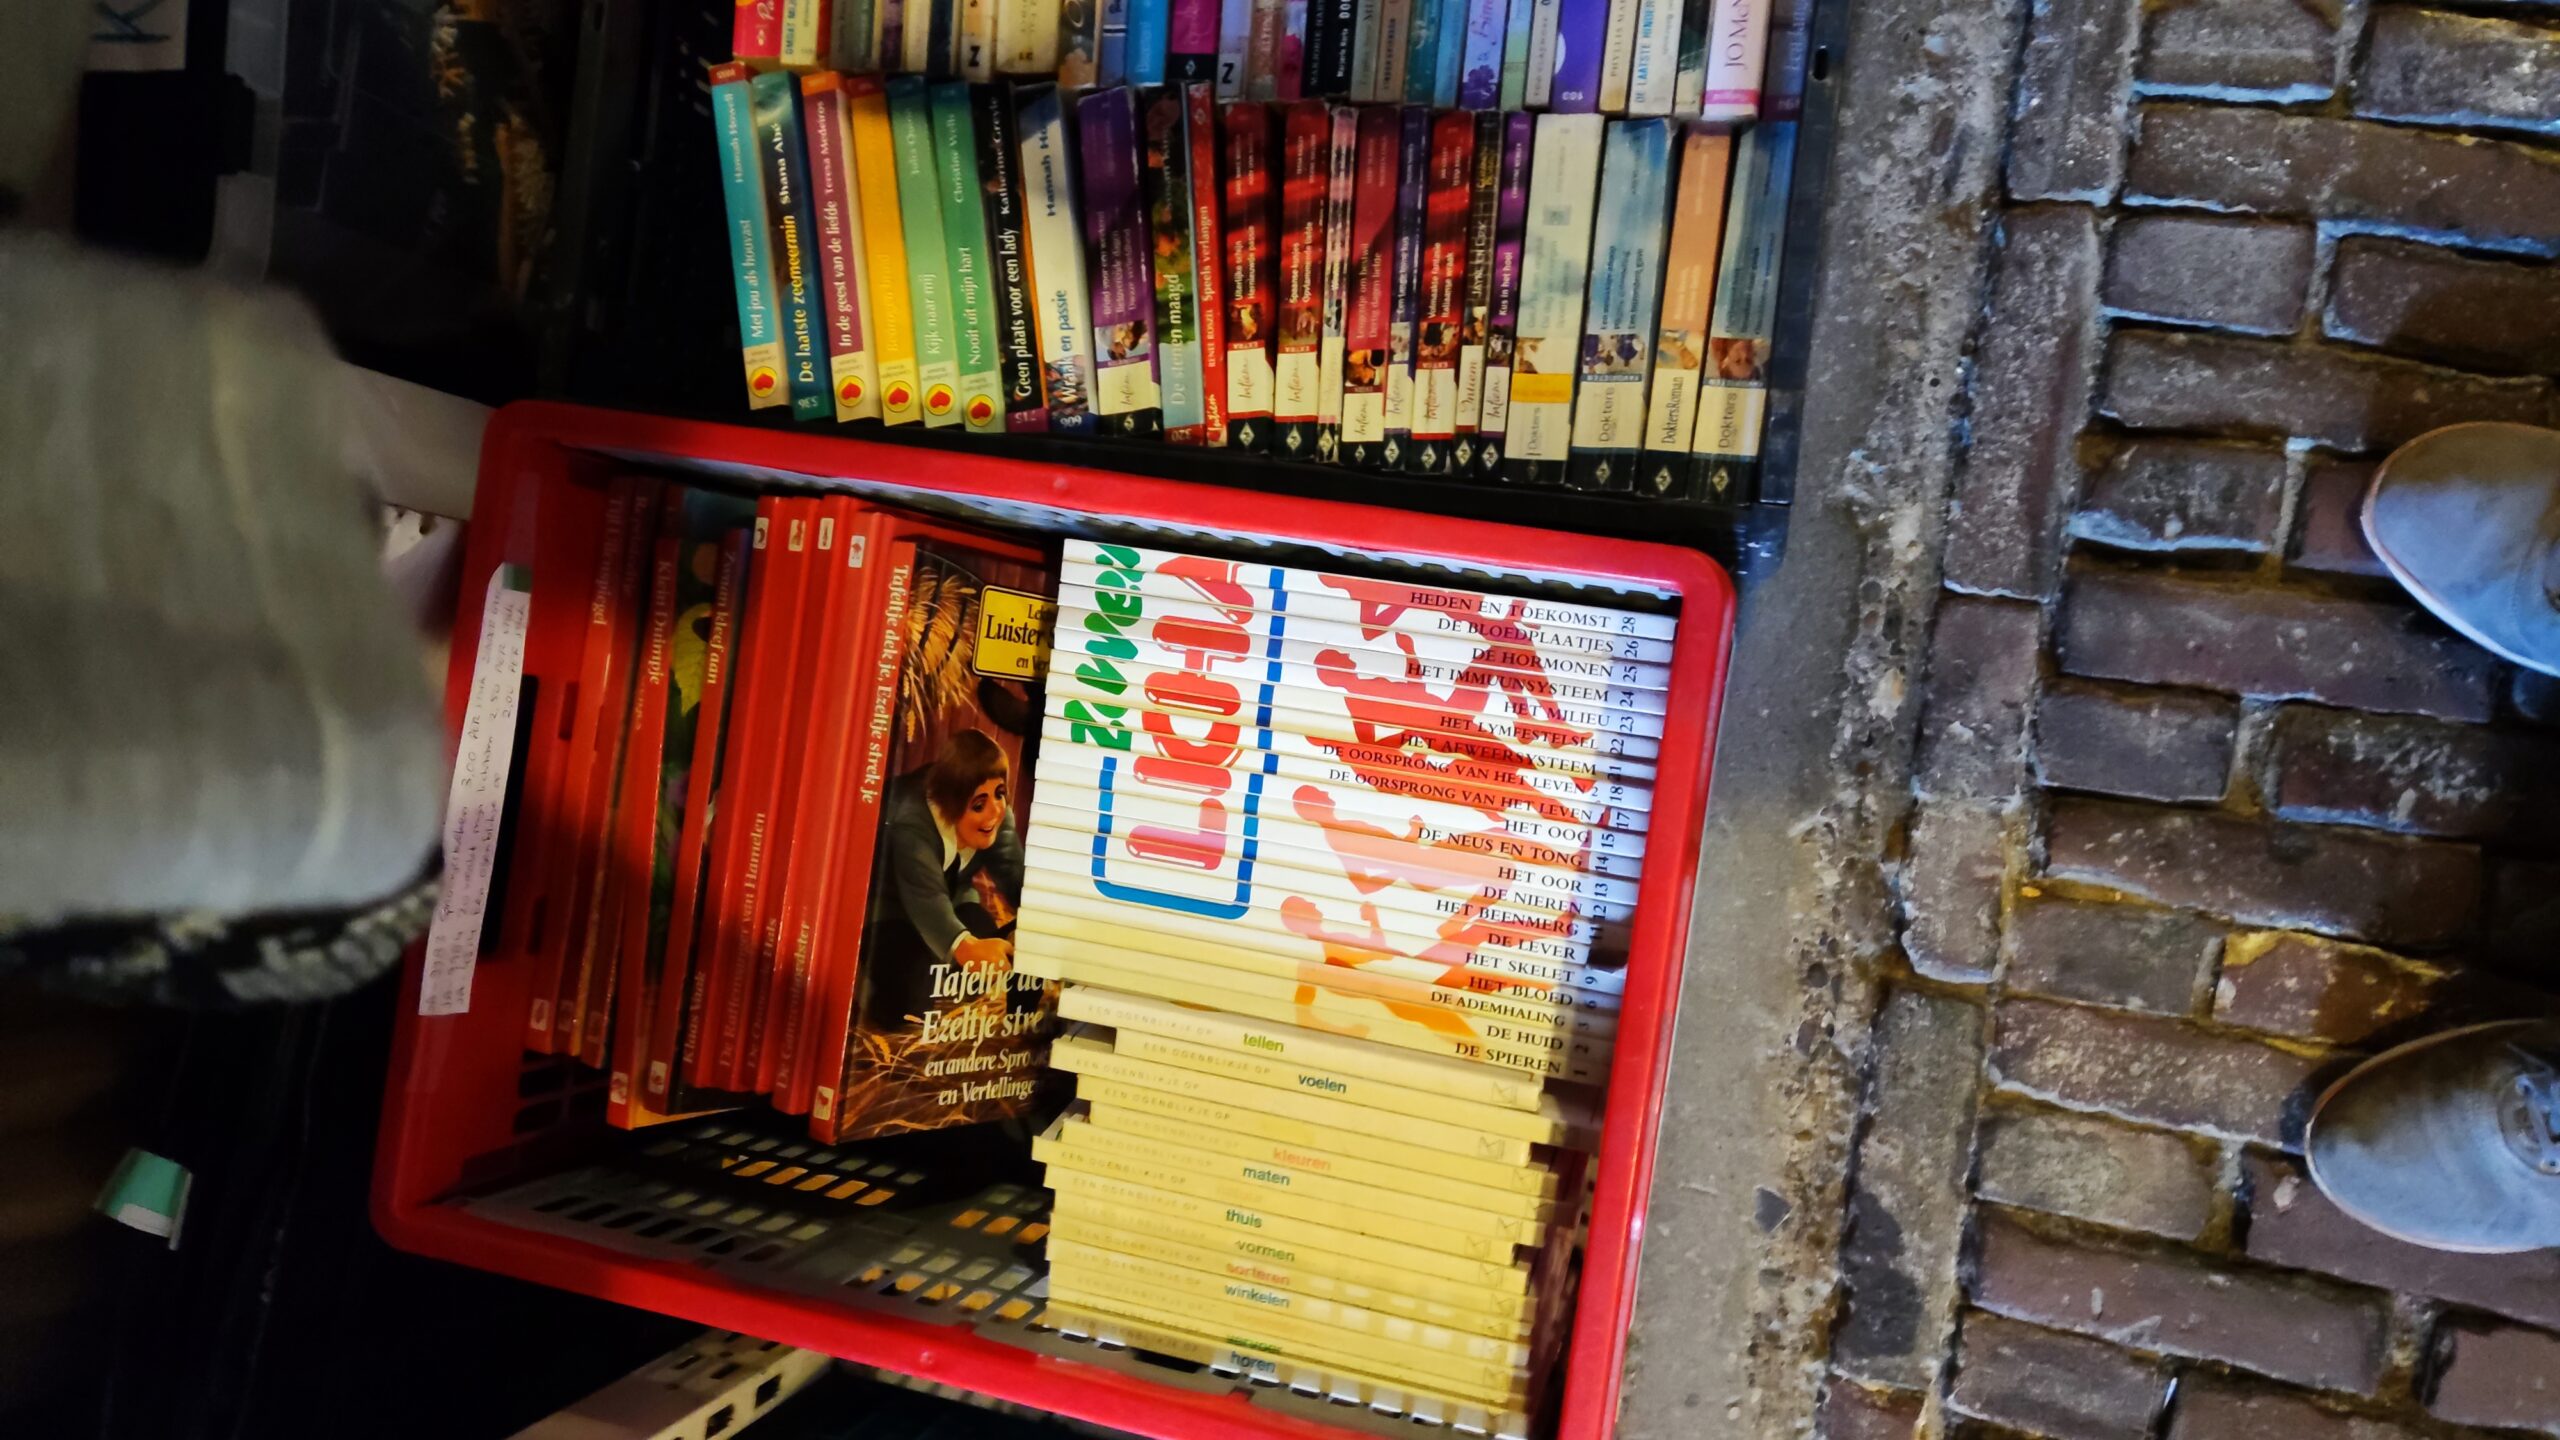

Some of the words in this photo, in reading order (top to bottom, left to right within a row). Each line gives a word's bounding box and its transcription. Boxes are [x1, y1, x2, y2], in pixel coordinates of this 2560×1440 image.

[777, 158, 792, 205] Shana
[822, 158, 834, 195] Teresa
[1042, 154, 1056, 217] Hannah
[825, 200, 841, 234] liefde
[739, 219, 757, 267] houvast
[827, 237, 843, 254] de
[999, 227, 1019, 256] lady
[1197, 206, 1214, 263] verlangen
[782, 216, 806, 304] zeemeermin
[833, 256, 846, 278] van
[958, 247, 973, 272] hart
[1006, 260, 1019, 283] een
[745, 270, 759, 287] als
[922, 273, 939, 295] mij
[961, 276, 979, 303] mijn
[1200, 265, 1216, 302] Speels
[1501, 271, 1511, 287] het
[747, 291, 765, 311] jou
[831, 281, 852, 312] geest
[1008, 286, 1022, 316] voor
[1164, 273, 1185, 324] maagd
[1499, 289, 1509, 298] in
[925, 301, 938, 327] naar
[964, 308, 978, 324] uit
[1052, 290, 1075, 331] passie
[1498, 300, 1508, 316] Kus
[750, 312, 765, 338] Met
[793, 310, 812, 357] laatste
[835, 315, 850, 331] de
[838, 333, 852, 347] In
[926, 330, 943, 355] Kijk
[967, 329, 982, 365] Nooit
[1010, 320, 1033, 358] plaats
[1060, 335, 1072, 352] en
[1168, 329, 1185, 379] stenen
[799, 361, 815, 384] De
[1016, 362, 1033, 397] Geen
[1058, 357, 1078, 403] Wraak
[1170, 382, 1186, 405] De
[1599, 386, 1615, 443] Dokters
[1718, 391, 1739, 449] Dokters
[655, 560, 673, 606] Klein
[886, 564, 910, 627] Tafeltje
[1410, 591, 1472, 611] HEDEN
[1478, 601, 1501, 615] EN
[1508, 604, 1612, 629] TOEKOMST
[710, 611, 729, 652] kleef
[985, 614, 1042, 647] Luister
[1438, 617, 1462, 631] DE
[1468, 621, 1615, 653] BLOEDPLAATJES
[1622, 615, 1636, 634] 28
[647, 611, 669, 685] Duimpje
[881, 629, 900, 659] dek
[1623, 640, 1639, 658] 26
[706, 652, 720, 684] aan
[876, 661, 896, 682] je,
[1016, 656, 1029, 669] en
[1472, 647, 1496, 662] DE
[1501, 651, 1613, 678] HORMONEN
[1622, 664, 1638, 683] 25
[1407, 662, 1444, 680] HET
[1449, 668, 1610, 702] IMMUUNSYSTEEM
[868, 684, 893, 740] Ezeltje
[1620, 690, 1635, 707] 24
[1503, 701, 1538, 716] HET
[1546, 707, 1611, 728] MILIEU
[1619, 716, 1635, 733] 23
[1439, 715, 1471, 731] HET
[1477, 721, 1600, 750] LYMFESTELSEL
[1404, 734, 1438, 748] HET
[1443, 740, 1597, 776] AFWEERSYSTEEM
[1609, 738, 1625, 755] 22
[864, 742, 883, 785] strek
[1323, 743, 1344, 758] DE
[1348, 748, 1449, 774] OORSPRONG
[1455, 765, 1488, 781] VAN
[1493, 770, 1526, 786] HET
[1532, 776, 1585, 796] LEVEN
[859, 786, 879, 804] je
[1328, 768, 1351, 782] DE
[1355, 773, 1456, 799] OORSPRONG
[1461, 789, 1496, 806] VAN
[1500, 795, 1535, 811] HET
[1539, 801, 1593, 822] LEVEN
[1609, 784, 1624, 802] 18
[1504, 819, 1540, 836] HET
[1548, 825, 1590, 843] OOG
[1616, 811, 1631, 828] 17
[744, 812, 766, 888] Hamelen
[1418, 826, 1442, 841] DE
[1447, 833, 1493, 852] NEUS
[1499, 841, 1524, 857] EN
[1529, 846, 1583, 867] TONG
[1601, 832, 1615, 849] 15
[1595, 856, 1609, 872] 14
[1497, 865, 1535, 882] HET
[1540, 874, 1583, 892] OOR
[1594, 882, 1608, 898] 13
[742, 893, 755, 923] van
[1483, 885, 1507, 900] DE
[1513, 891, 1583, 913] NIEREN
[1593, 904, 1608, 921] 12
[1436, 899, 1473, 917] HET
[1479, 906, 1579, 938] BEENMERG
[1487, 932, 1512, 948] DE
[1518, 939, 1576, 960] LEVER
[1465, 952, 1501, 969] HET
[1507, 960, 1575, 983] SKELET
[929, 960, 1015, 1003] Tafeltje
[1469, 975, 1504, 992] HET
[1511, 985, 1574, 1007] BLOED
[1430, 991, 1453, 1005] DE
[1456, 996, 1566, 1028] ADEMHALING
[921, 1005, 997, 1047] Ezeltje
[1486, 1024, 1511, 1040] DE
[1516, 1030, 1564, 1051] HUID
[1243, 1032, 1285, 1053] tellen
[924, 1059, 945, 1078] en
[946, 1051, 996, 1076] andere
[1455, 1041, 1480, 1057] DE
[1485, 1048, 1562, 1074] SPIEREN
[938, 1088, 958, 1106] en
[1298, 1073, 1347, 1095] voelen
[1273, 1147, 1332, 1172] kleuren
[1242, 1164, 1291, 1187] maten
[1225, 1208, 1263, 1229] thuis
[1234, 1239, 1296, 1263] vormen
[1225, 1261, 1291, 1286] sorteren
[1224, 1282, 1291, 1309] winkelen
[1230, 1350, 1276, 1374] horen
